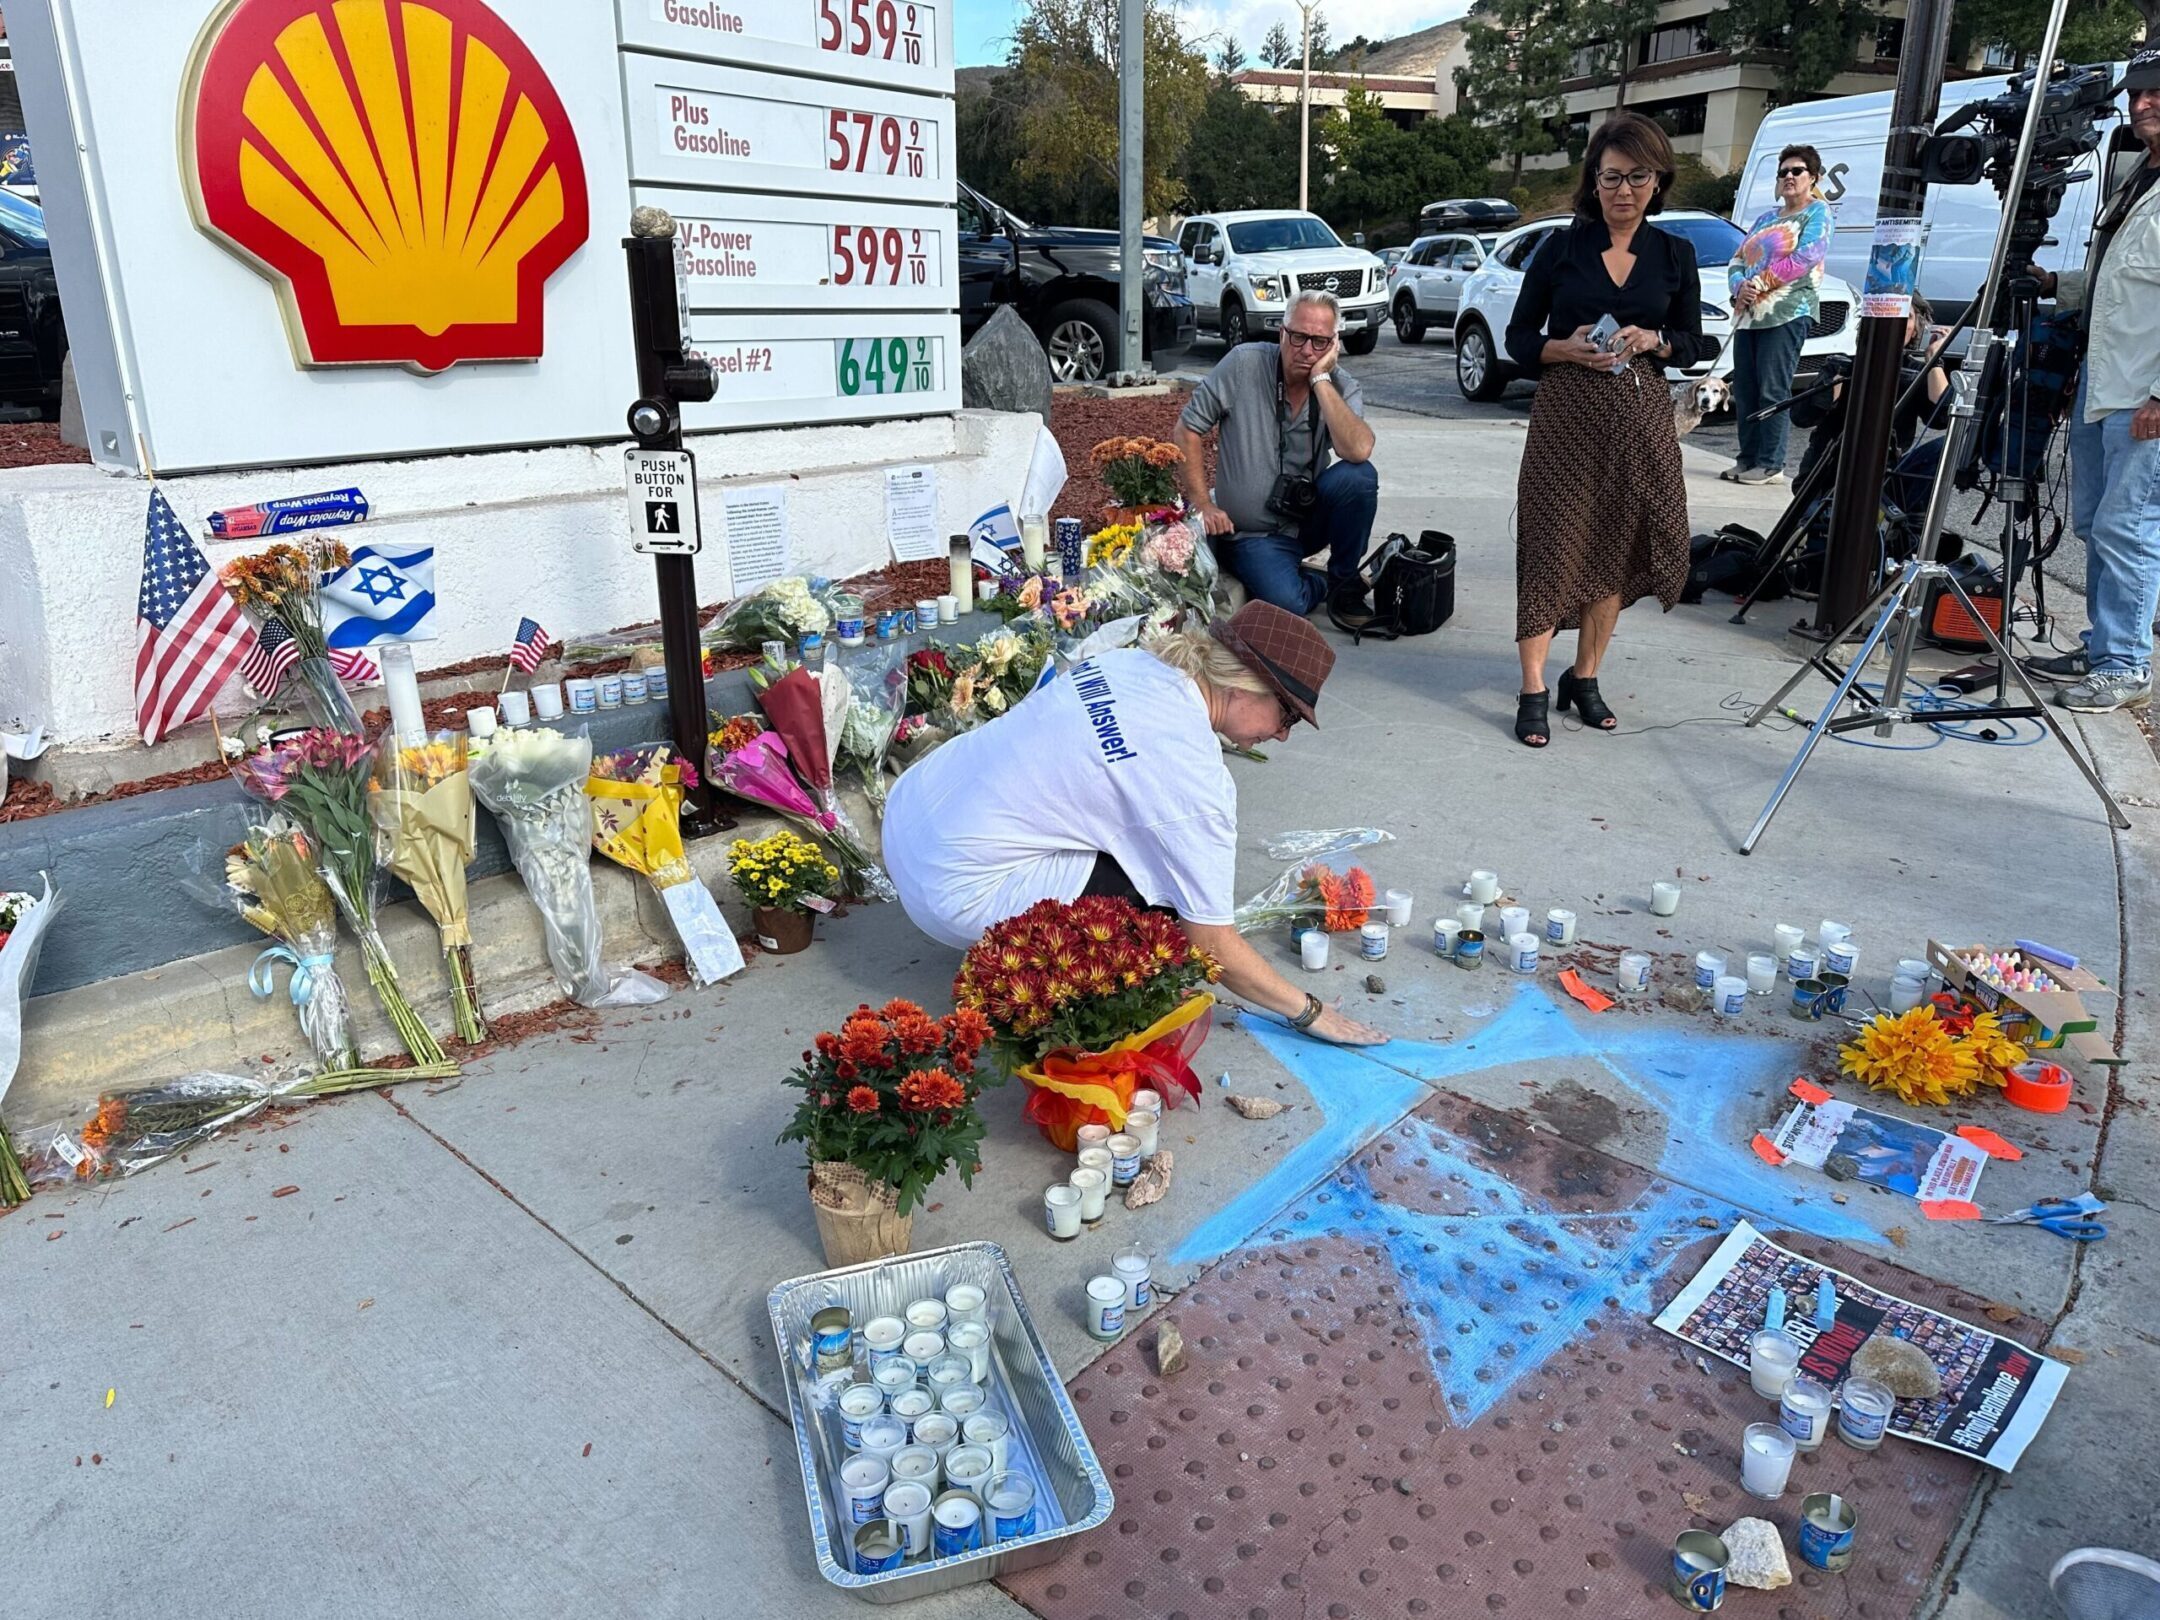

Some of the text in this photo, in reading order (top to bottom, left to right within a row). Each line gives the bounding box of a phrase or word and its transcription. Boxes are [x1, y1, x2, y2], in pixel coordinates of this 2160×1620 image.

[664, 0, 743, 33] Gasoline
[820, 0, 898, 60] 559
[906, 4, 917, 32] 9
[904, 37, 920, 65] 10
[671, 95, 709, 126] Plus
[674, 127, 751, 157] Gasoline
[828, 110, 901, 175] 579
[909, 119, 919, 146] 9
[907, 152, 923, 178] 10
[680, 223, 752, 252] V-Power
[911, 228, 921, 254] 9
[683, 250, 757, 278] Gasoline
[833, 225, 903, 286] 599
[910, 259, 926, 285] 10
[746, 347, 772, 372] #2
[916, 336, 926, 361] 9
[839, 337, 909, 397] 649
[914, 366, 930, 391] 10
[635, 473, 685, 486] BUTTON
[641, 459, 676, 473] PUSH
[272, 493, 350, 509] Reynolds Wrap
[648, 486, 673, 498] FOR
[280, 509, 354, 528] Reynolds Wrap
[1075, 675, 1112, 702] Will
[1084, 699, 1138, 764] Answer!
[2023, 1035, 2034, 1044] 48
[1802, 1355, 1839, 1380] IS
